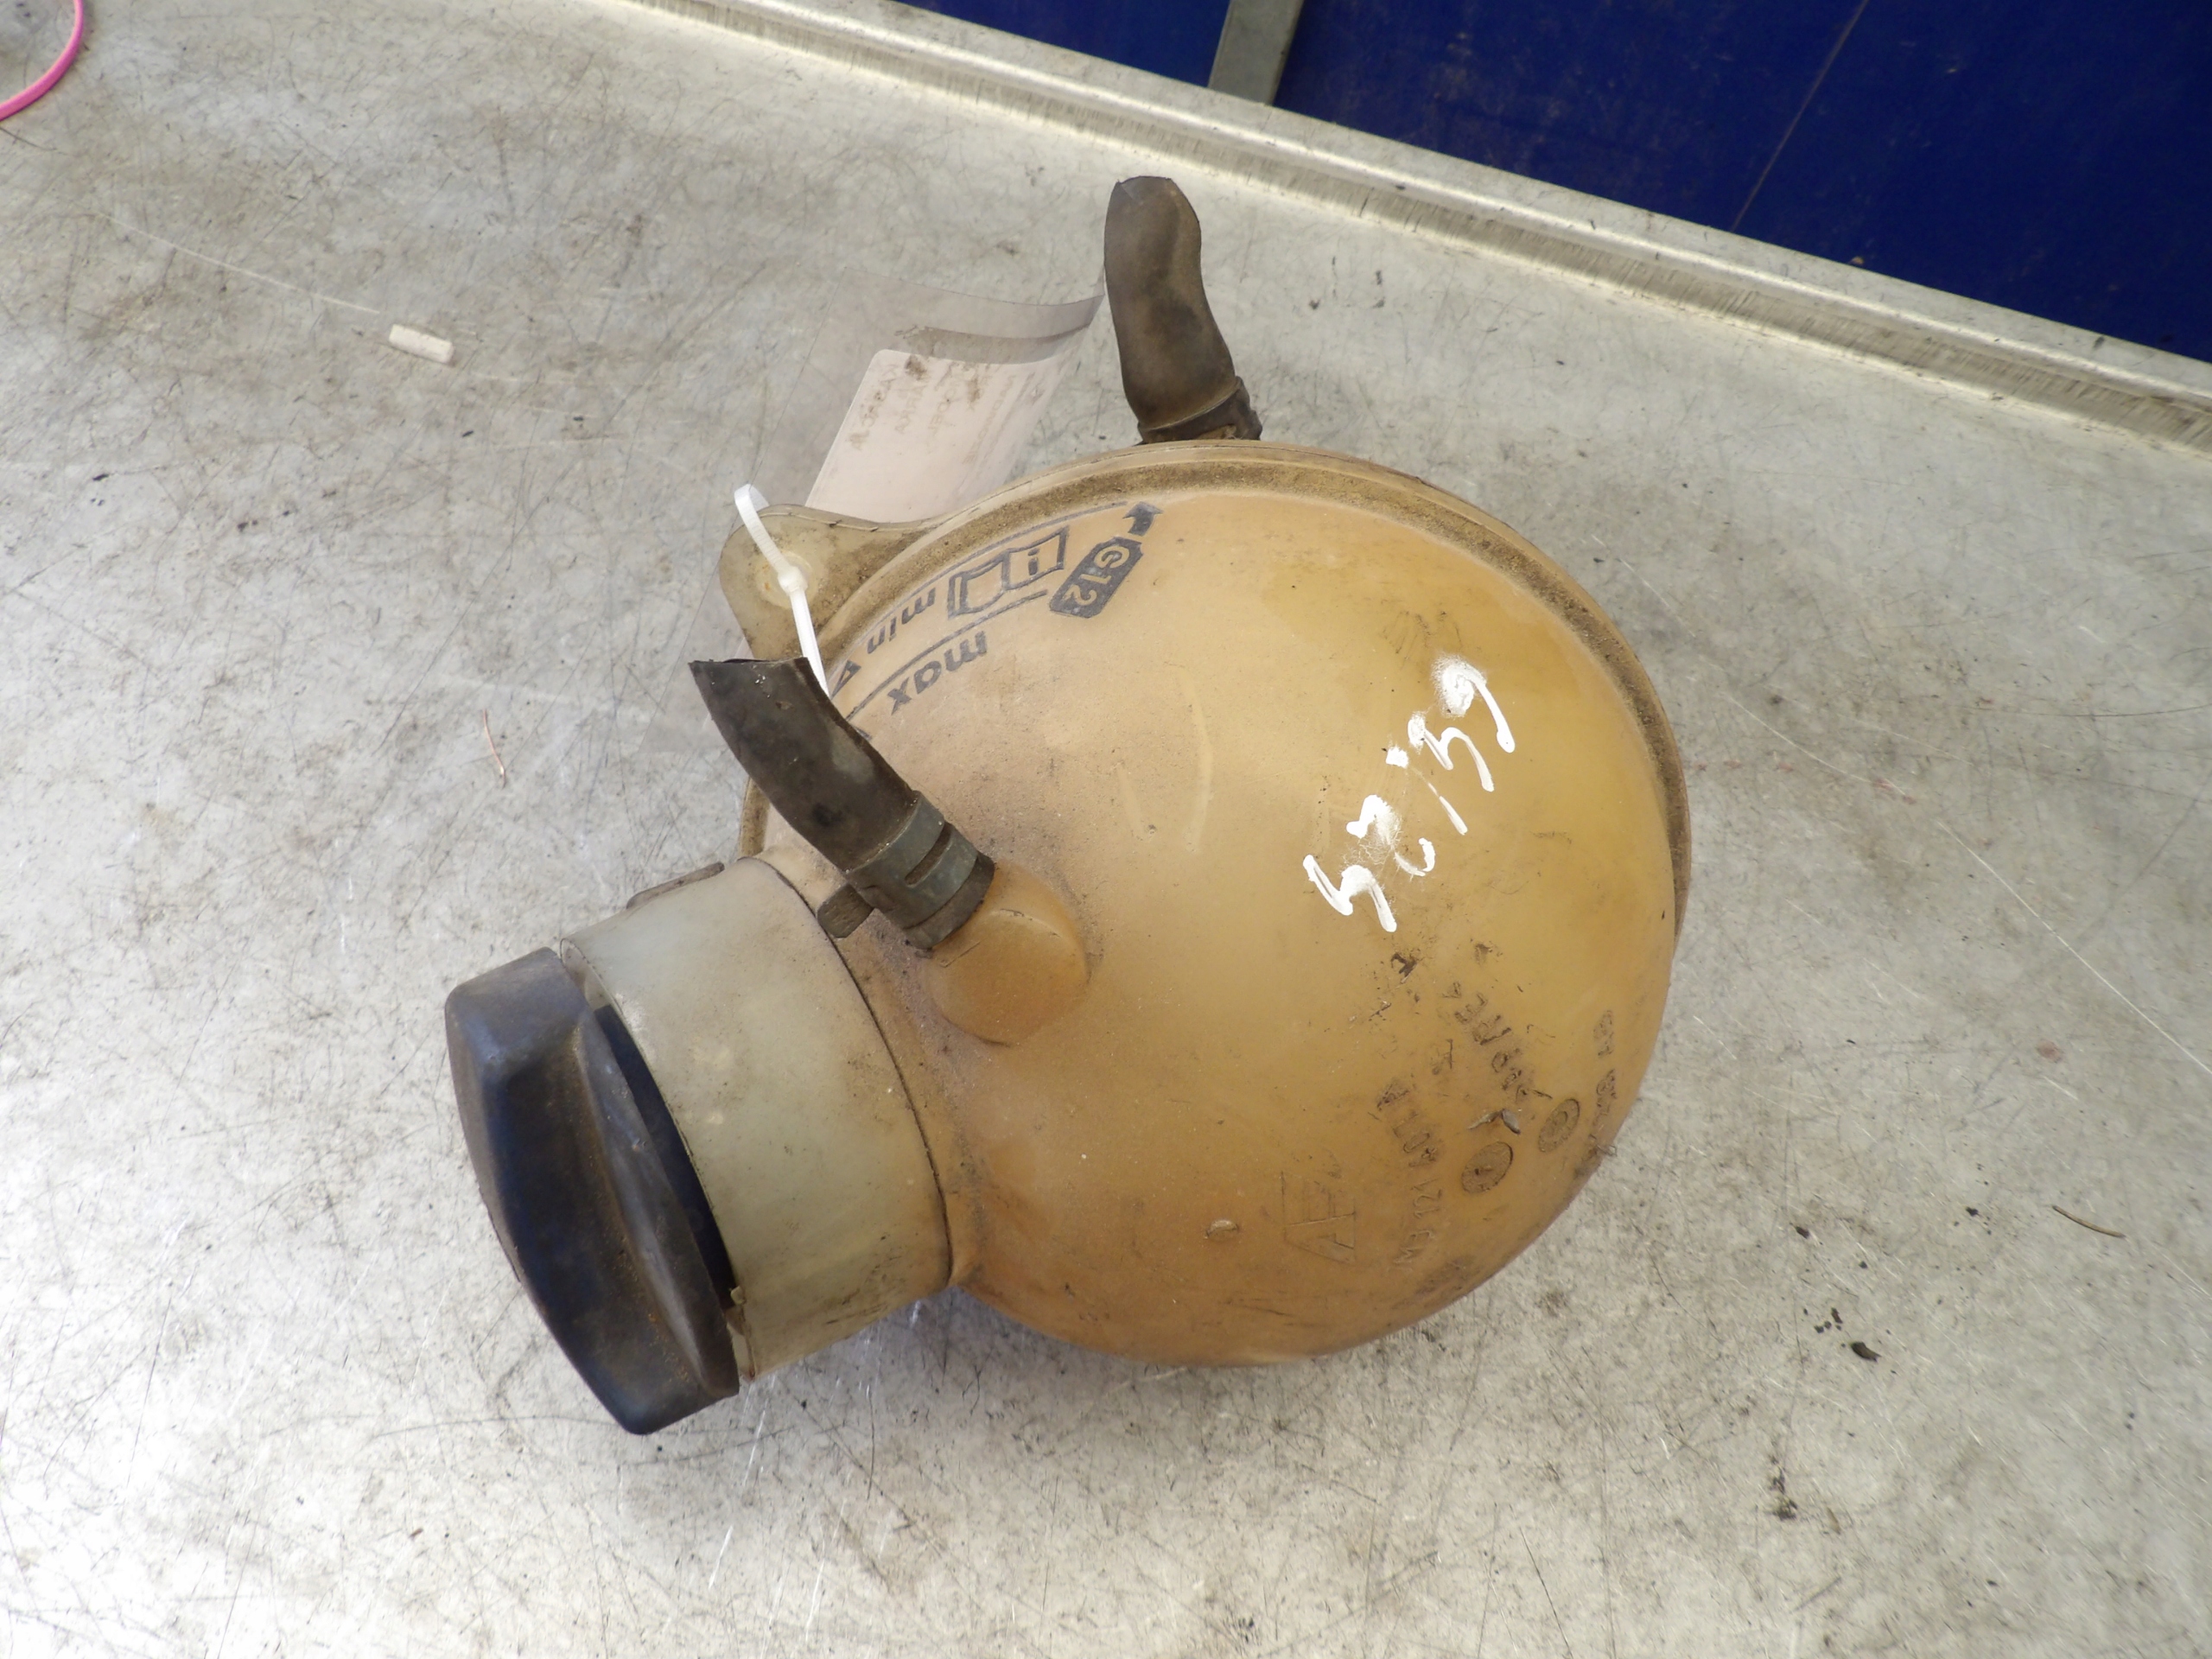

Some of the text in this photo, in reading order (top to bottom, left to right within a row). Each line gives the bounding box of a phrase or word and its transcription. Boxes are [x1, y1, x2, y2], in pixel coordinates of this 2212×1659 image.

[1066, 544, 1130, 607] G12
[867, 588, 937, 654] min
[887, 631, 988, 715] max
